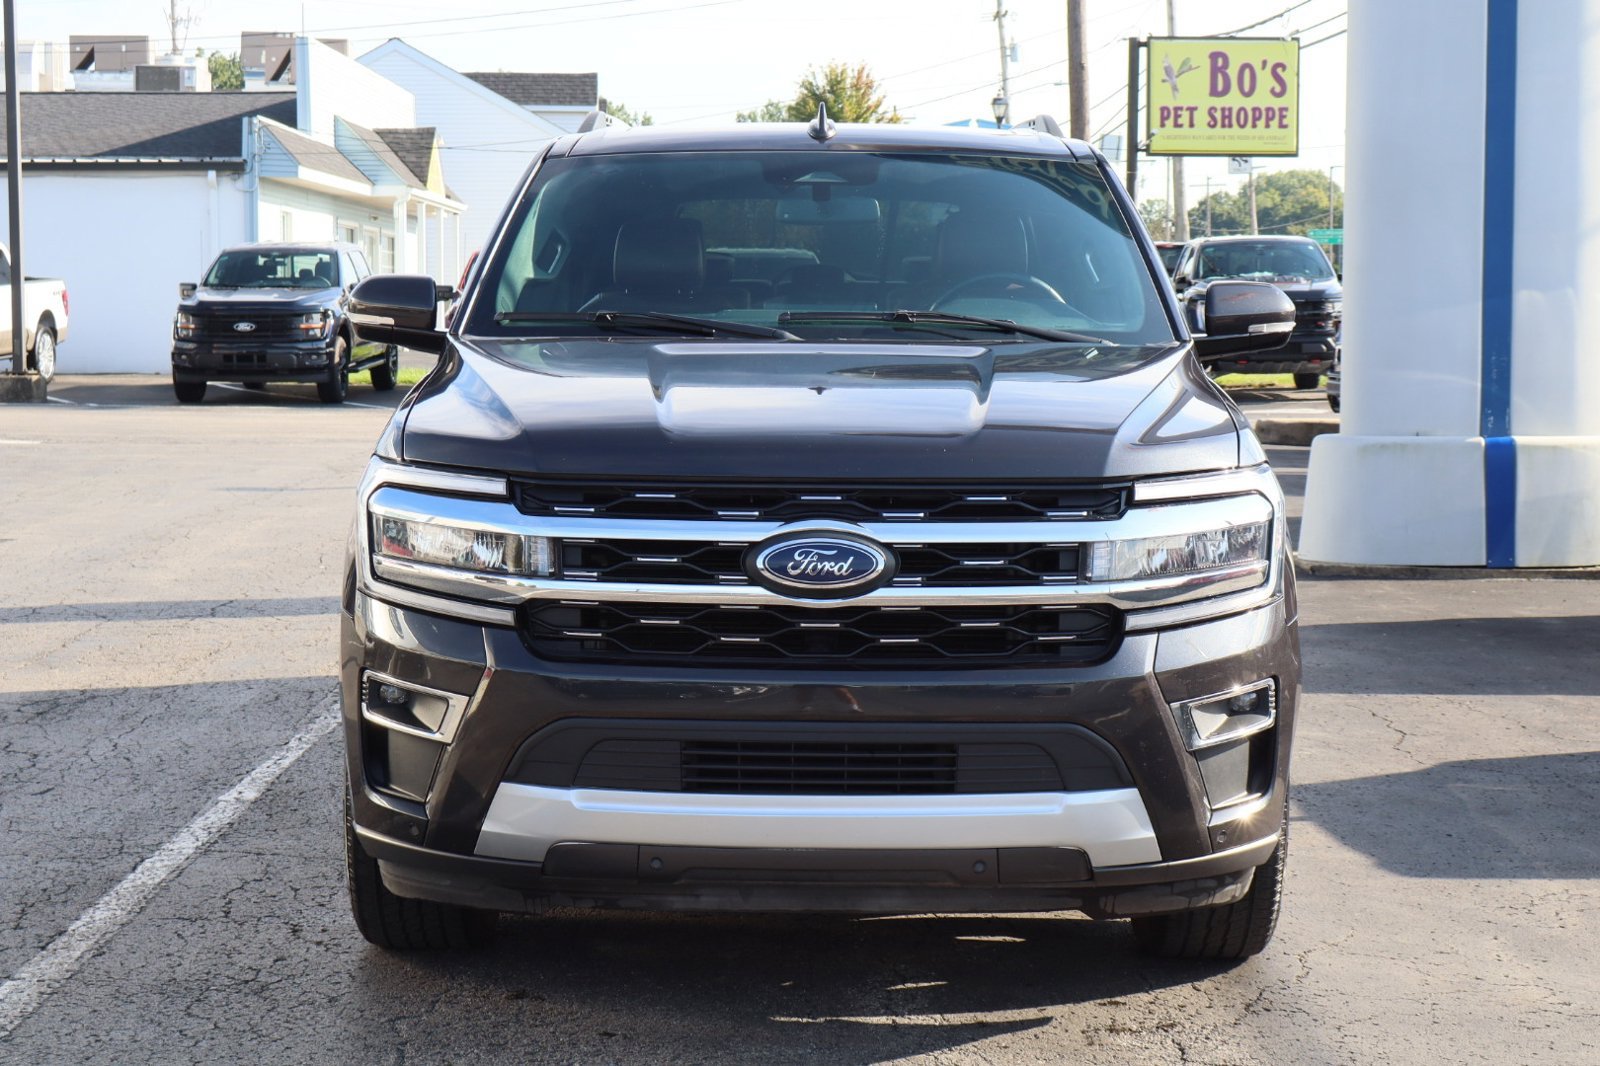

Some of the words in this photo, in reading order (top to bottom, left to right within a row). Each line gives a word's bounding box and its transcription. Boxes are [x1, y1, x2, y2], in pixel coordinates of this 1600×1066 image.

[1159, 106, 1198, 128] PET
[1207, 106, 1289, 129] SHOPPE
[787, 548, 854, 576] Ford
